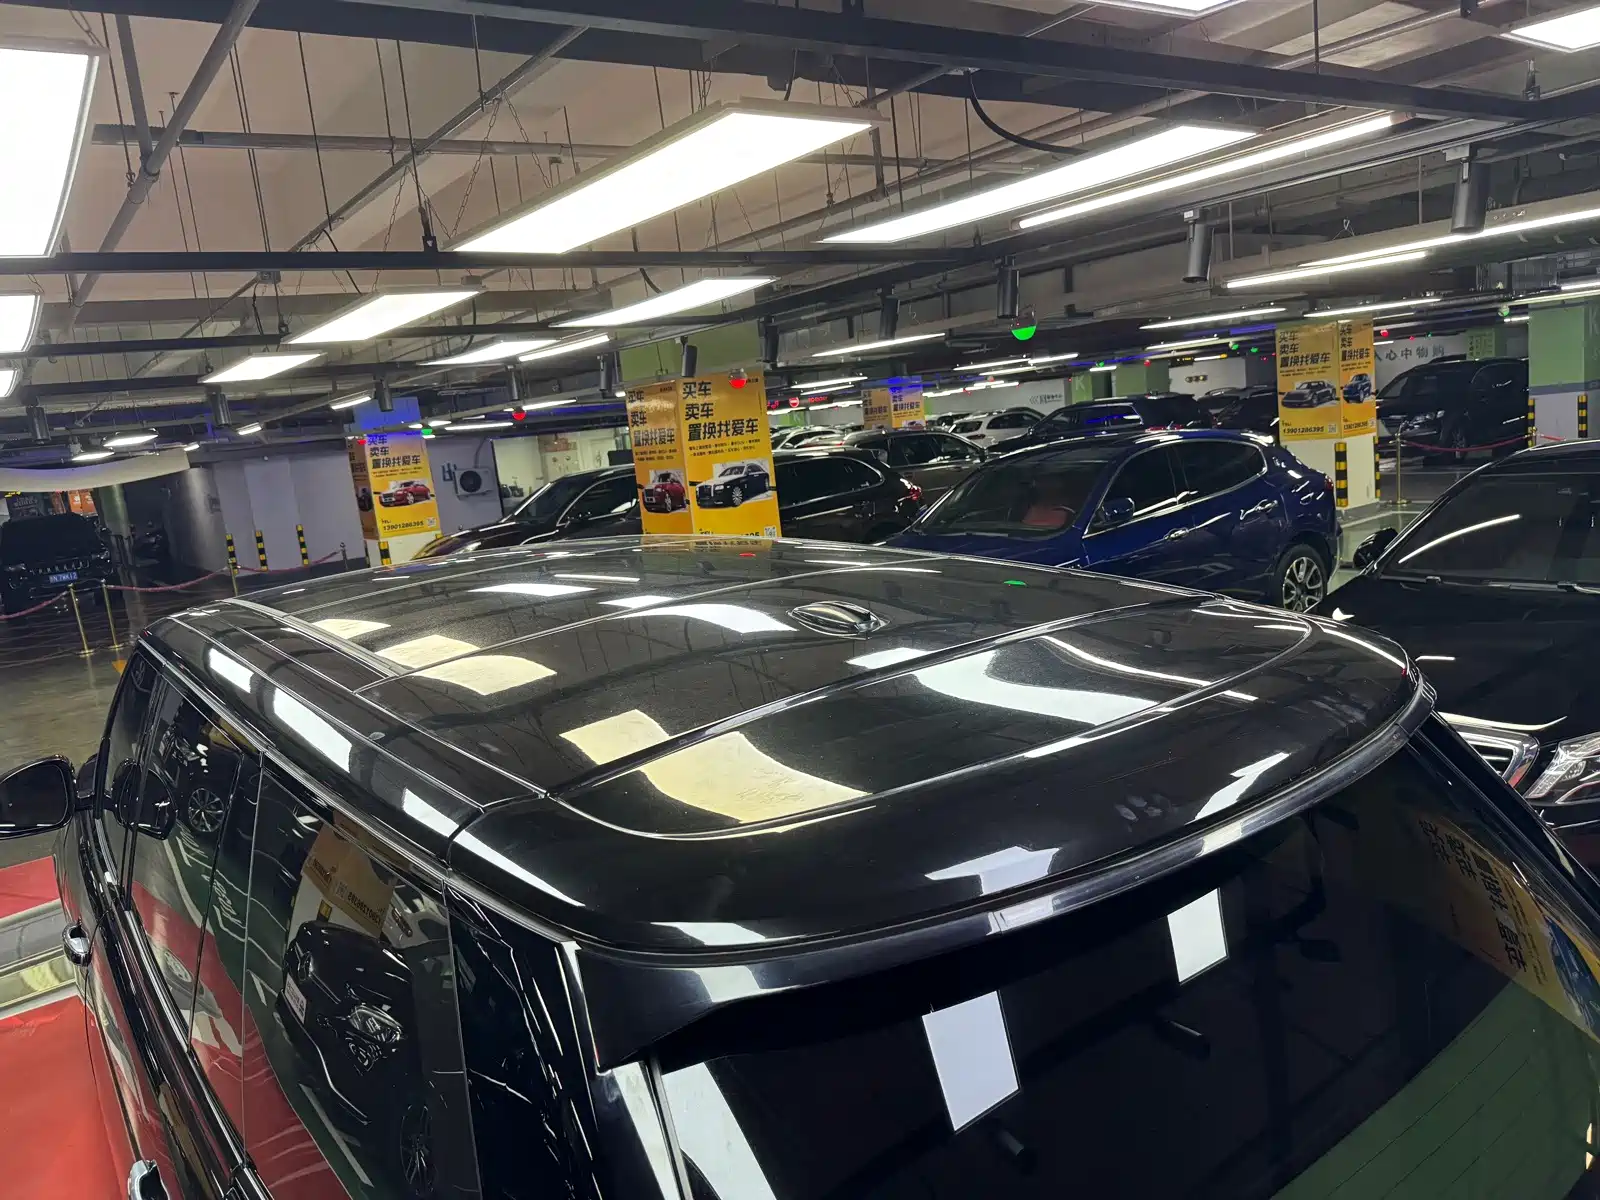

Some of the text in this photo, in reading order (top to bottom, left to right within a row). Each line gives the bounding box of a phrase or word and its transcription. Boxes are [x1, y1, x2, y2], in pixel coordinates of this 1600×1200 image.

[1279, 330, 1299, 343] 买车
[682, 381, 712, 400] 买车
[630, 410, 648, 428] 卖车
[685, 402, 714, 421] 卖车
[633, 428, 675, 447] 置换找爱车
[688, 418, 759, 442] 置换找爱车
